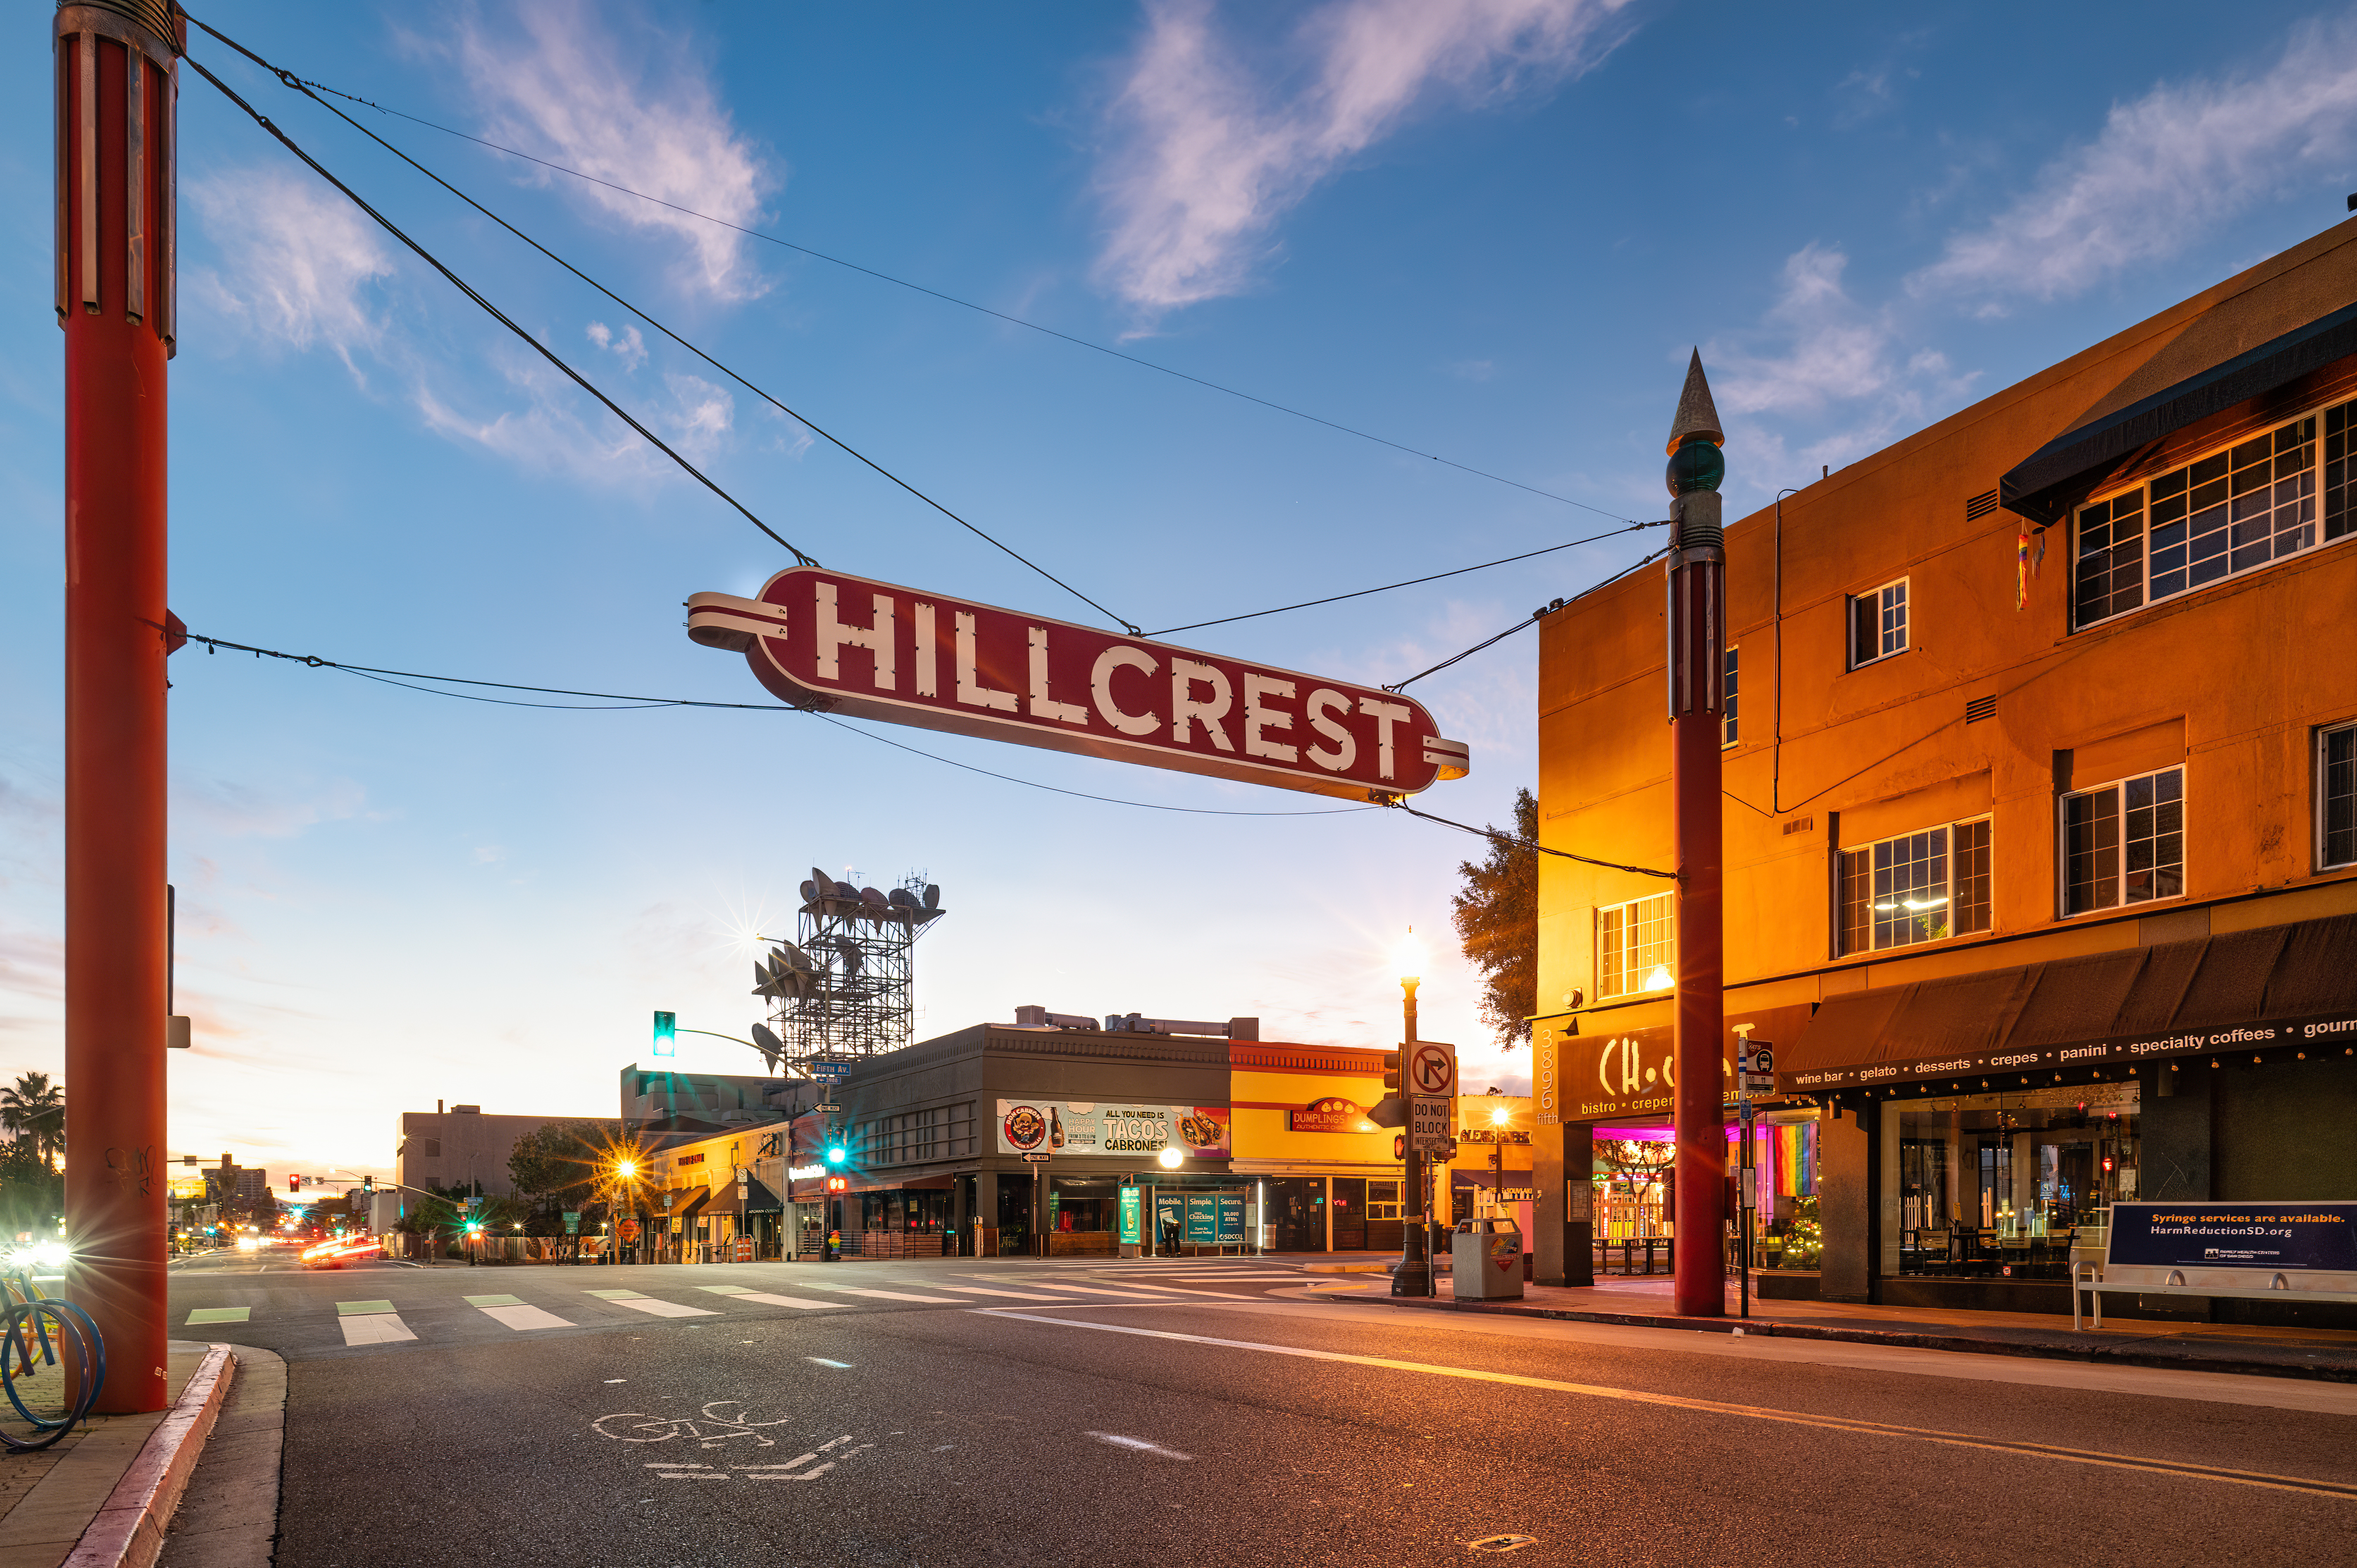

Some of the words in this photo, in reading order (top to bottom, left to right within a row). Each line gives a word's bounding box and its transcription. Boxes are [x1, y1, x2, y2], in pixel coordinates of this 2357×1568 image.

[816, 581, 1411, 780] HILLCREST
[1796, 1074, 1821, 1084] wine
[1825, 1072, 1843, 1082] bar
[1860, 1066, 1897, 1081] gelato
[1915, 1059, 1971, 1073] desserts
[1990, 1053, 2038, 1066] crepes
[2060, 1044, 2107, 1061] panini
[2130, 1035, 2205, 1054] specialty
[2210, 1029, 2275, 1044] coffees
[1542, 1029, 1553, 1109] 3896
[1415, 1104, 1427, 1116] DO
[1431, 1104, 1447, 1117] NOT
[1582, 1101, 1616, 1114] bistro
[1294, 1113, 1345, 1124] DUMPLINGS
[1537, 1112, 1558, 1125] fifth
[1103, 1119, 1169, 1140] TACOS
[1415, 1121, 1447, 1134] BLOCK
[2152, 1214, 2196, 1224] Syringe
[2200, 1214, 2250, 1222] services
[2280, 1214, 2345, 1223] available.
[2151, 1226, 2292, 1237] HarmReductionSD.org
